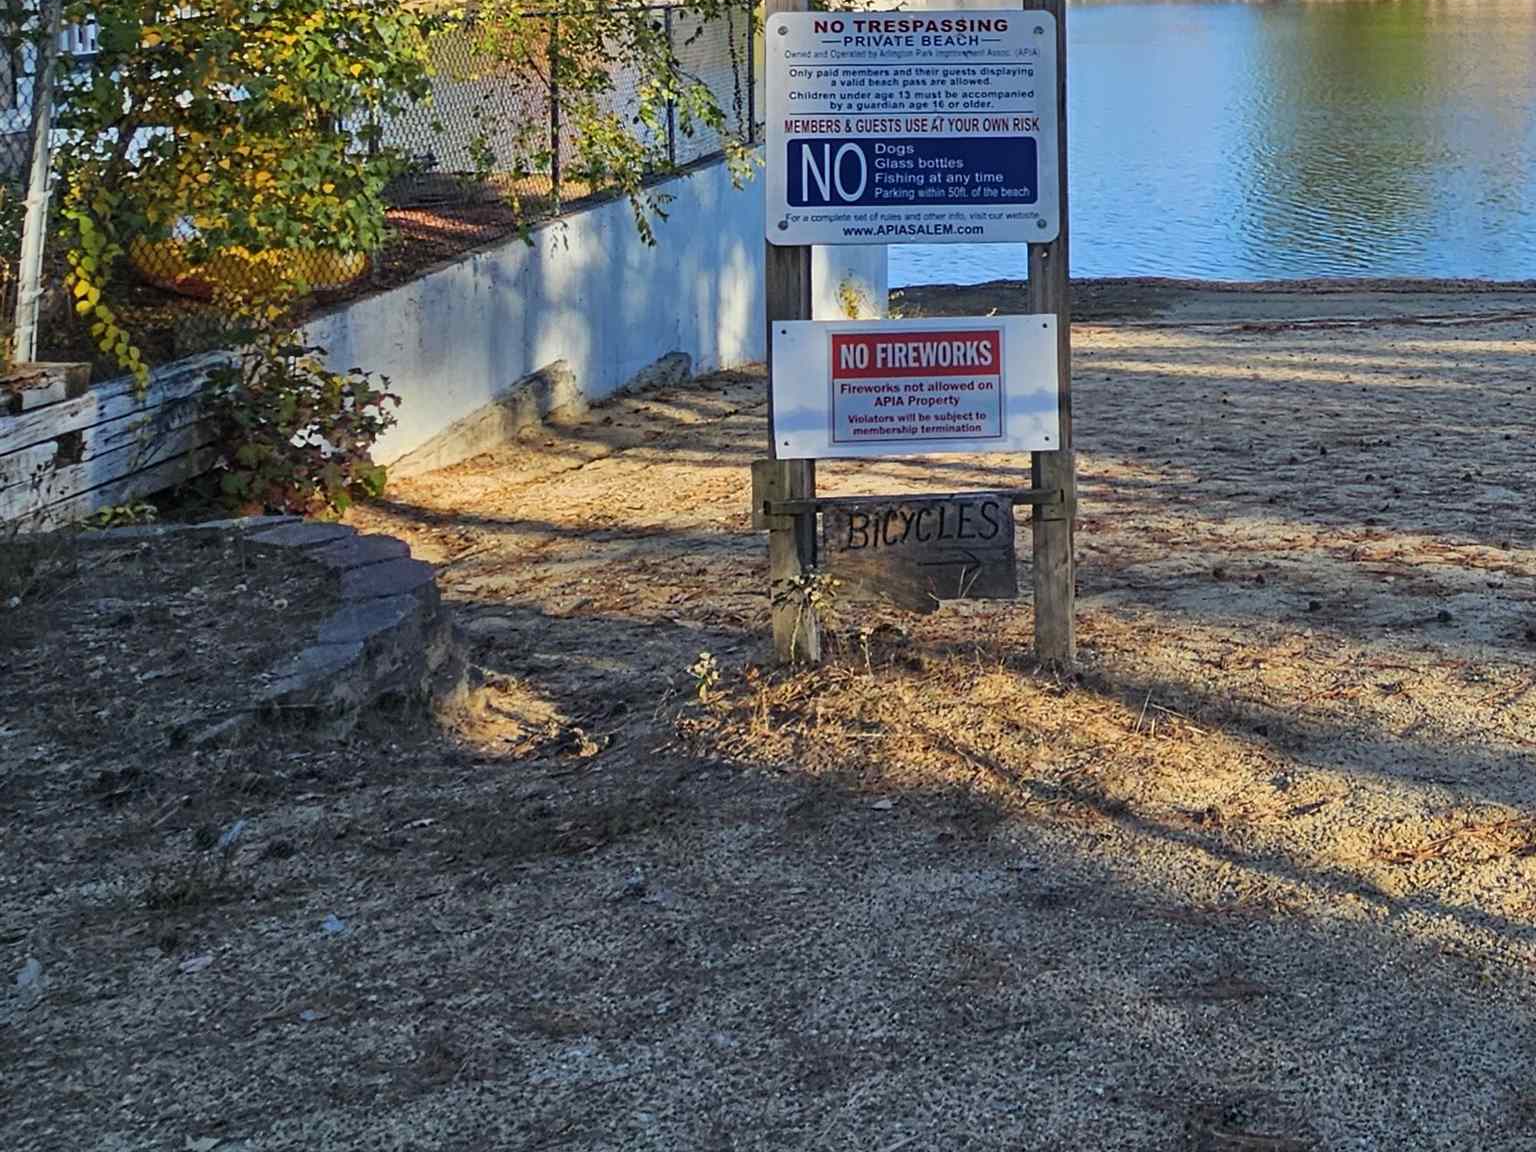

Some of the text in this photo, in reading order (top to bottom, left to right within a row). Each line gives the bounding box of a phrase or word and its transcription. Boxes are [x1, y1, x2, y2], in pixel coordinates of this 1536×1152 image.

[814, 19, 1008, 33] NO TRESPASSING
[844, 35, 978, 46] PRIVATE BEACH
[814, 50, 828, 58] and
[868, 50, 877, 58] by
[789, 69, 813, 79] Only
[817, 69, 839, 78] paid
[842, 69, 889, 77] members
[915, 68, 939, 76] their
[942, 68, 977, 77] guests
[980, 68, 1034, 77] displaying
[902, 79, 927, 87] pass
[950, 78, 992, 86] allowed.
[789, 92, 836, 100] Children
[899, 91, 911, 99] 13
[914, 91, 942, 99] must
[945, 90, 958, 98] be
[962, 90, 1034, 99] accompanied
[830, 102, 841, 111] by
[857, 101, 905, 110] guardian
[909, 101, 928, 109] age
[963, 100, 994, 108] older.
[785, 117, 1040, 133] MEMBERS & GUESTS USE AT YOUR OWN RISK
[875, 143, 914, 156] Dogs
[875, 157, 964, 169] Glass bottles
[802, 143, 867, 202] NO
[875, 172, 1003, 185] Fishing at any time
[875, 185, 1030, 200] Parking within 50ft. of the beach
[785, 213, 800, 222] For
[811, 214, 851, 222] complete
[854, 213, 867, 221] set
[869, 213, 878, 221] of
[970, 212, 986, 220] visit
[843, 223, 984, 235] www.APIASALEM.com
[840, 340, 992, 369] NO FIREWORKS
[840, 381, 993, 394] Fireworks not allowed on
[875, 395, 960, 407] APIA Property
[849, 412, 986, 423] Violators will be subject to
[853, 424, 981, 435] membership termination
